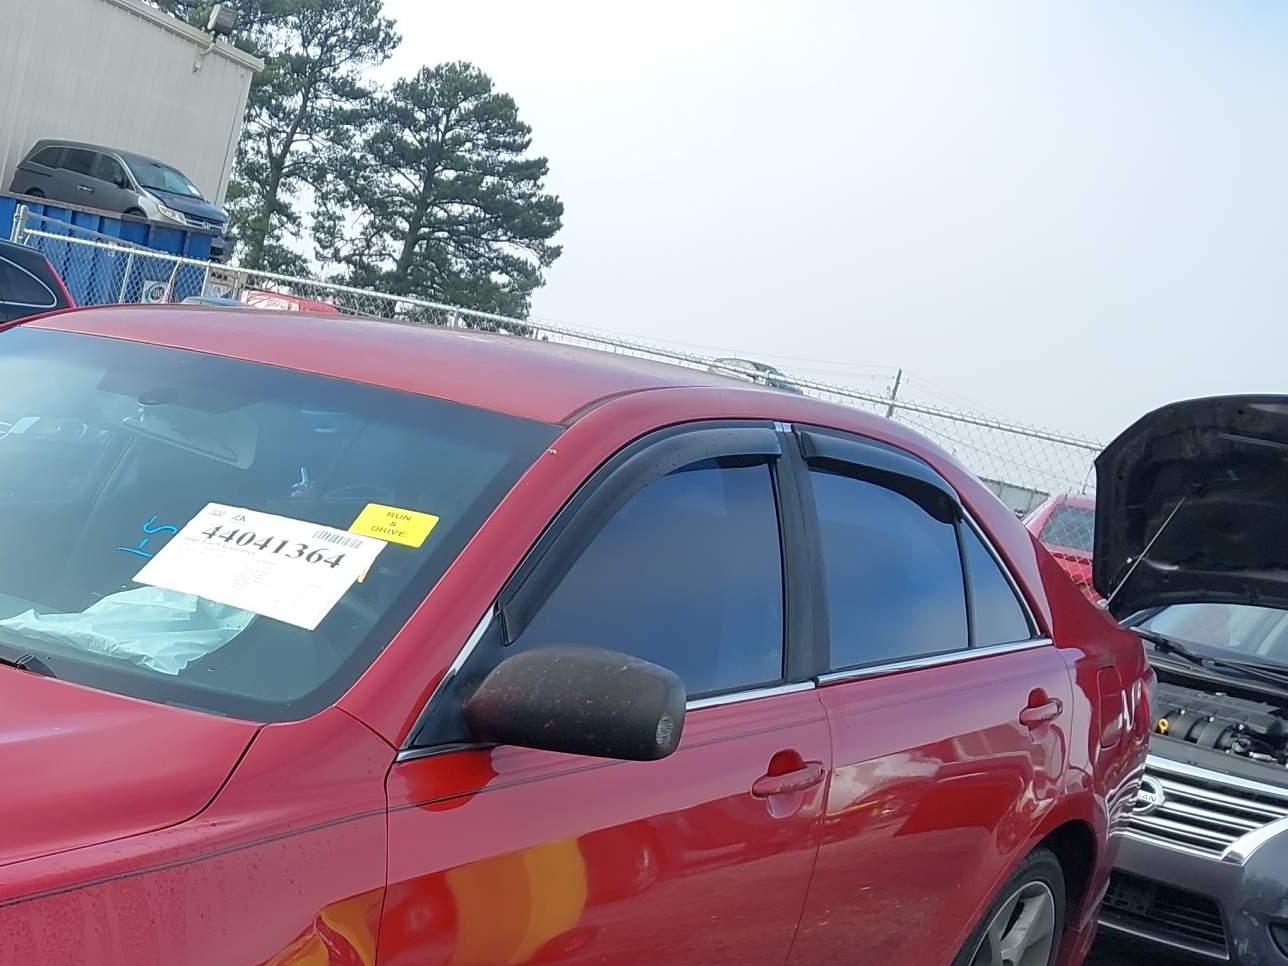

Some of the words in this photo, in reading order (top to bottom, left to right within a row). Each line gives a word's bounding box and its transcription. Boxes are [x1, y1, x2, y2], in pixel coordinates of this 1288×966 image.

[387, 511, 412, 521] RUN
[370, 525, 407, 537] DRIVE
[202, 525, 346, 568] 44041364
